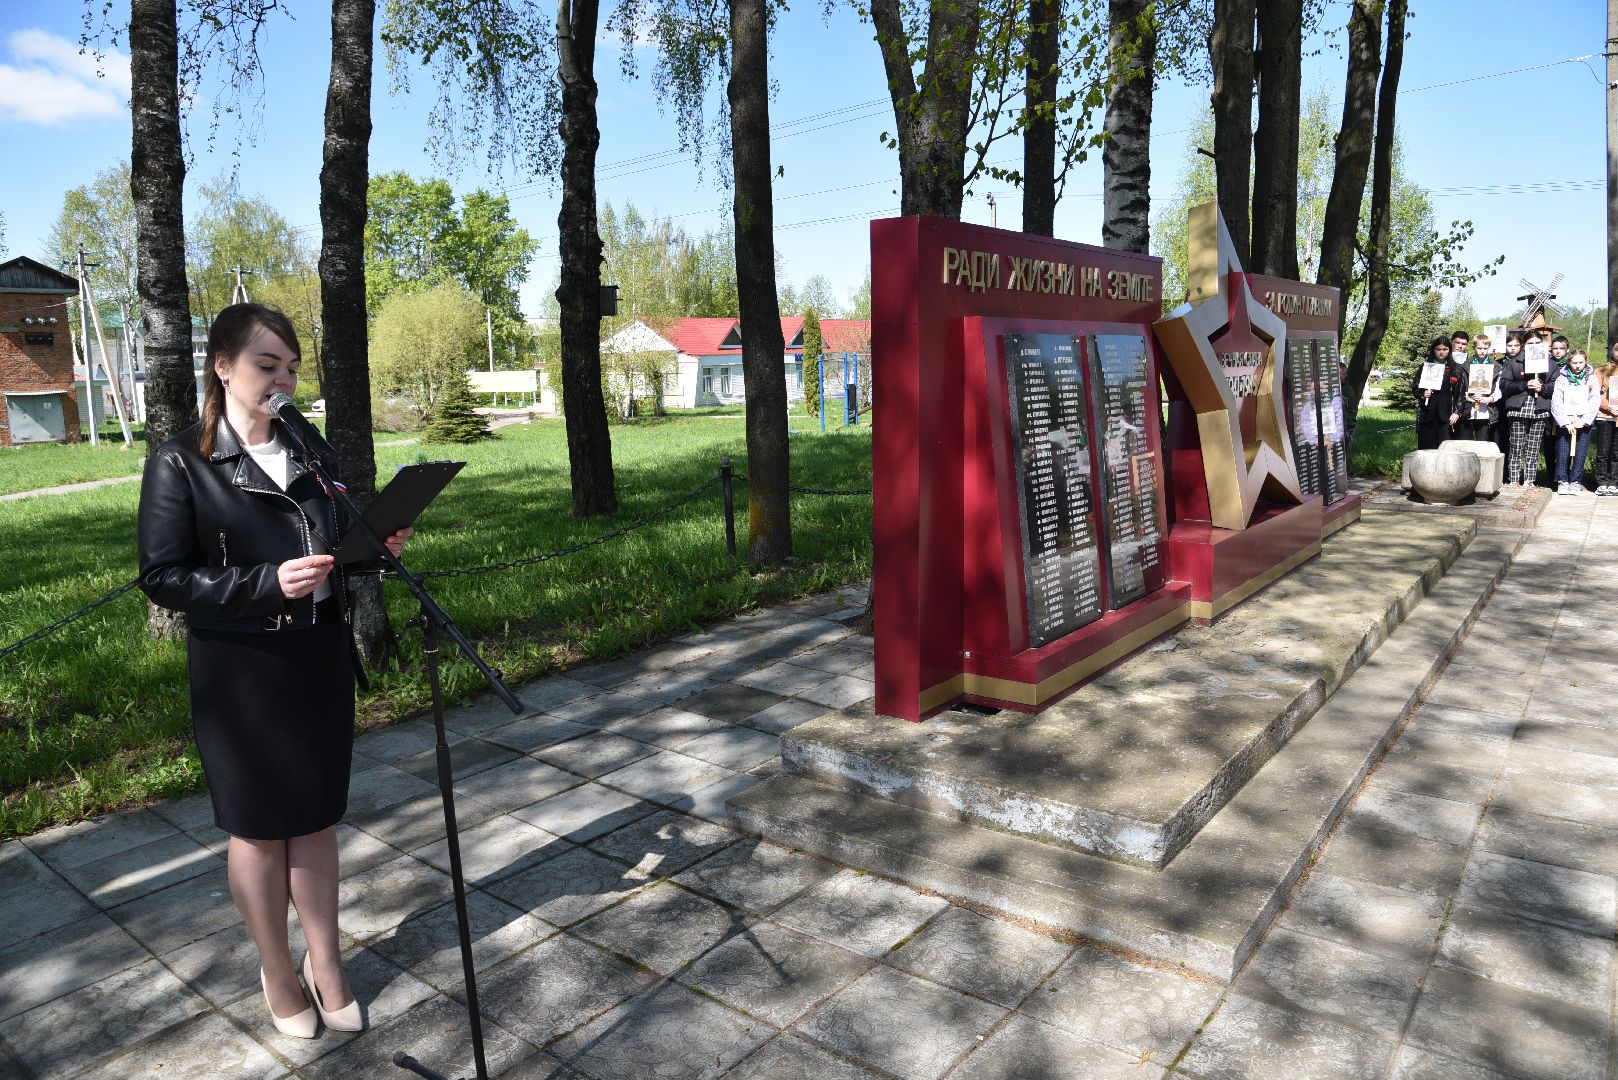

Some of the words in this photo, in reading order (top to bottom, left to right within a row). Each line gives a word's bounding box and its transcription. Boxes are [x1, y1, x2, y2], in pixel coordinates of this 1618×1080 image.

[943, 247, 1000, 294] РАДИ
[1007, 255, 1075, 296] ЖИЗНИ
[1080, 266, 1103, 298] НА
[1107, 270, 1154, 303] ЗЕМЛЕ
